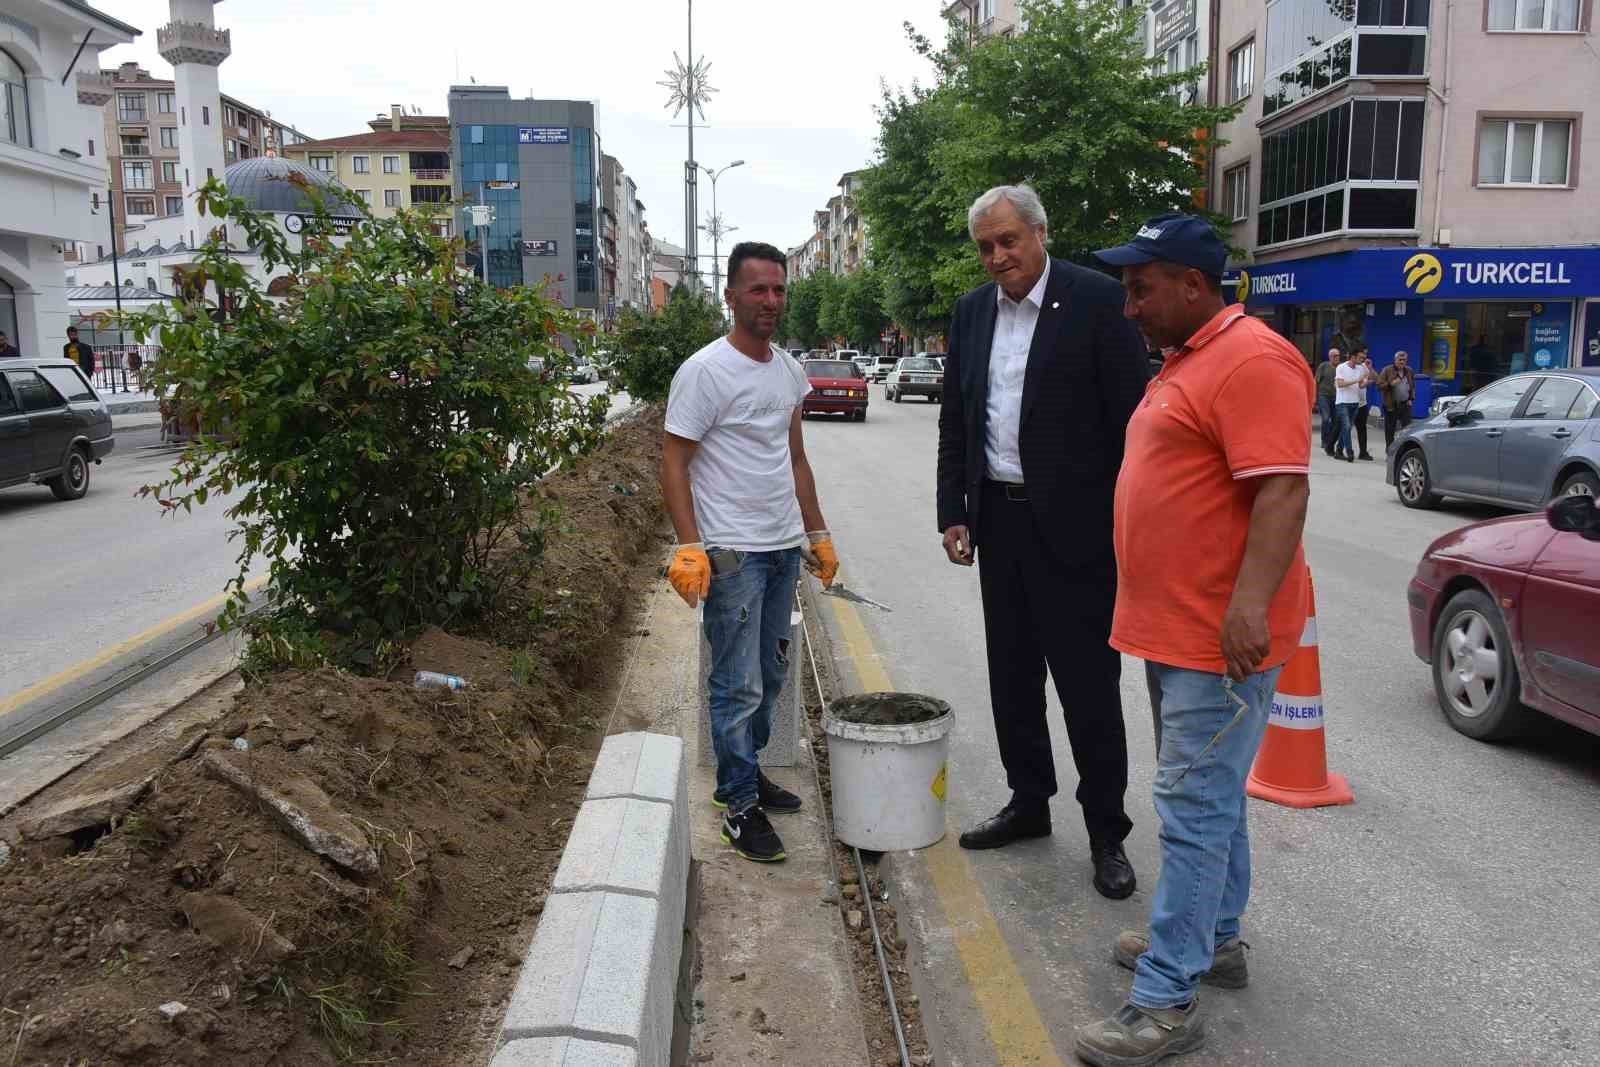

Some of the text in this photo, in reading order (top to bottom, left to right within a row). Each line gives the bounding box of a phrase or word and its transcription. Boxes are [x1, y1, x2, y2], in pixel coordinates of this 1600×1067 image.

[1252, 273, 1297, 295] TURKCELL
[1451, 262, 1570, 284] TURKCELL
[1285, 703, 1316, 721] İŞLERİ
